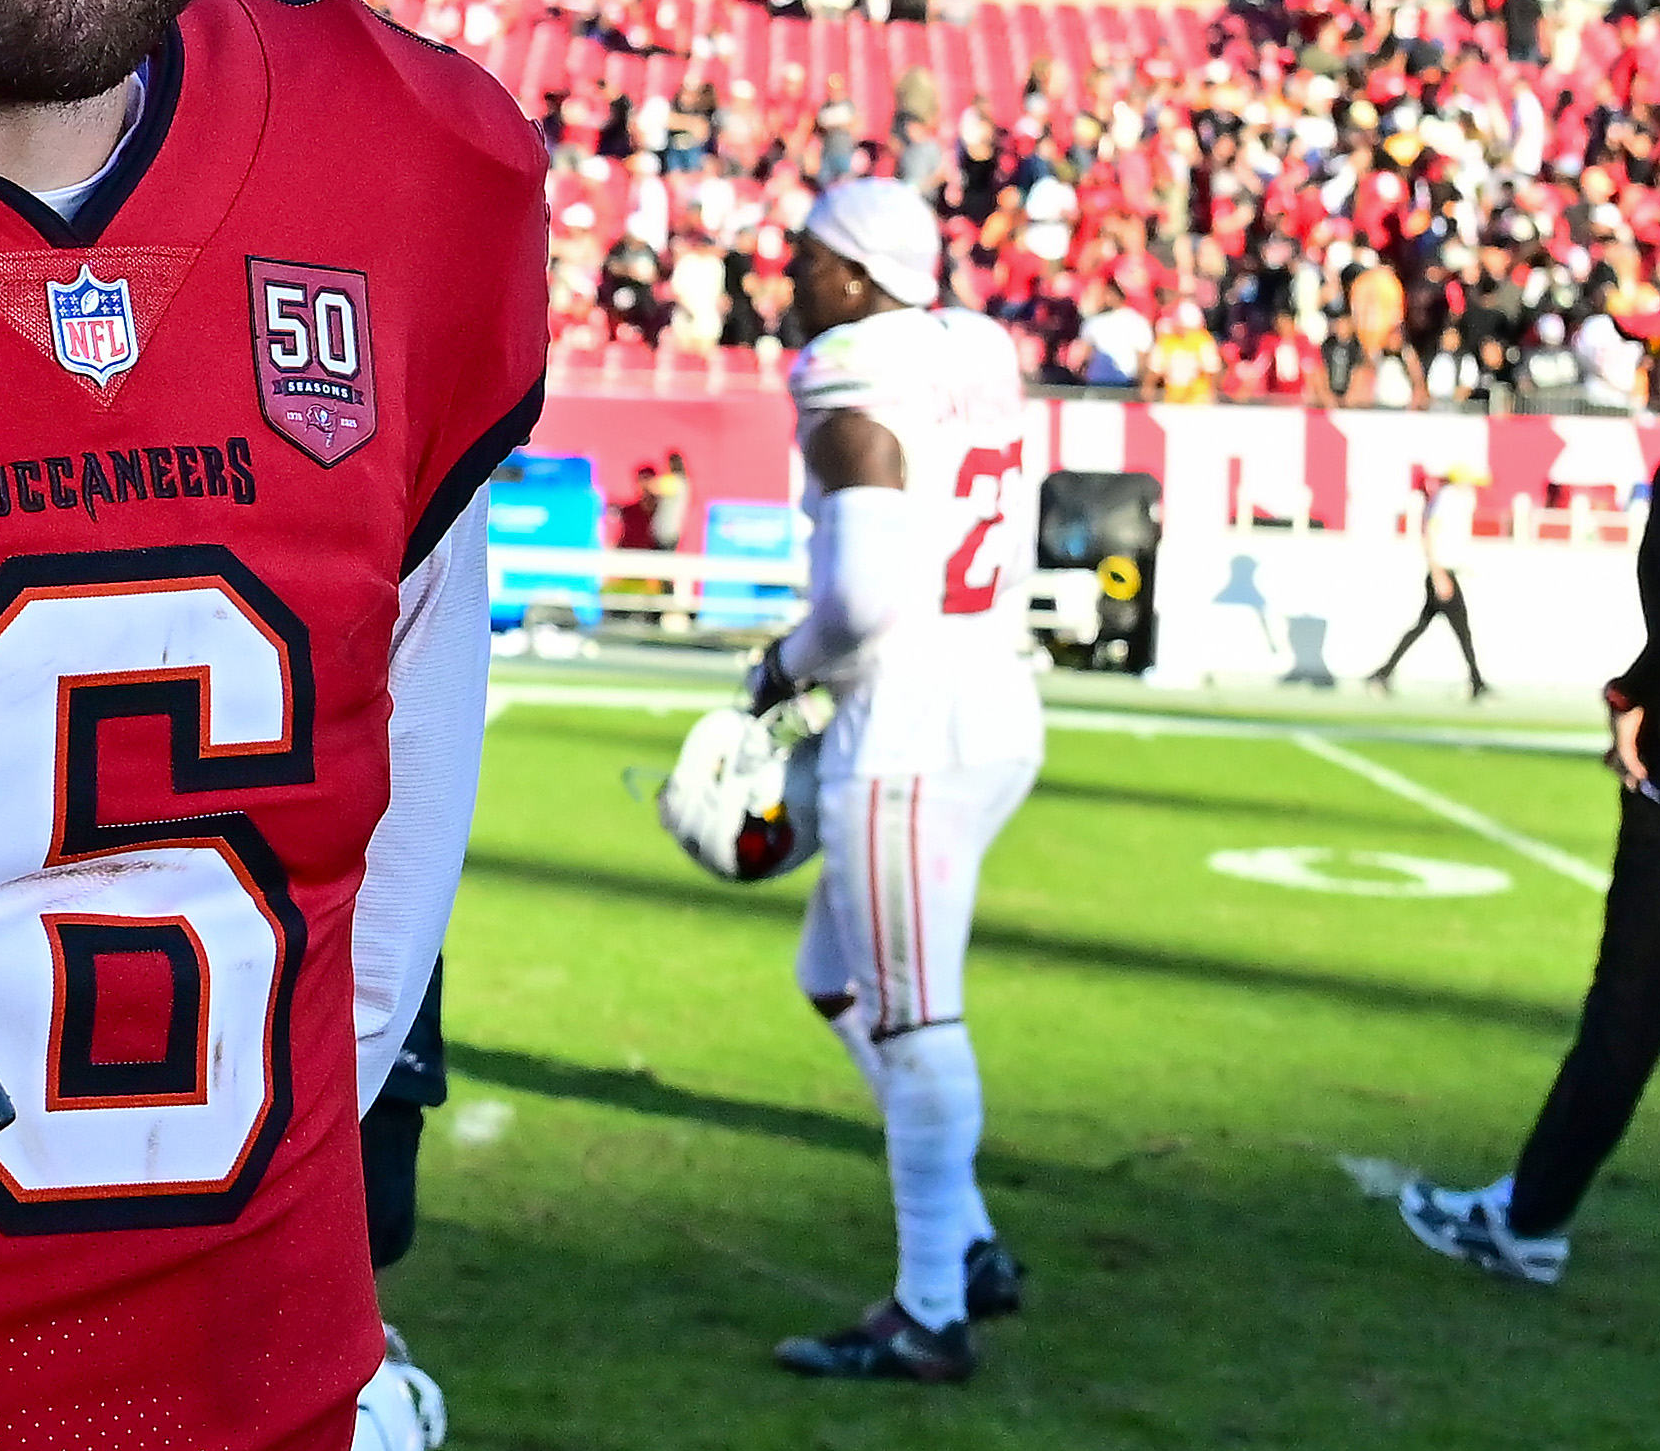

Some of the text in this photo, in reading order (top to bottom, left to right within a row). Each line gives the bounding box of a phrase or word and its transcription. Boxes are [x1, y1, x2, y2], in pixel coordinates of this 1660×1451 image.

[66, 320, 126, 363] NFL
[265, 282, 362, 380] 50
[288, 381, 350, 398] SEASONS
